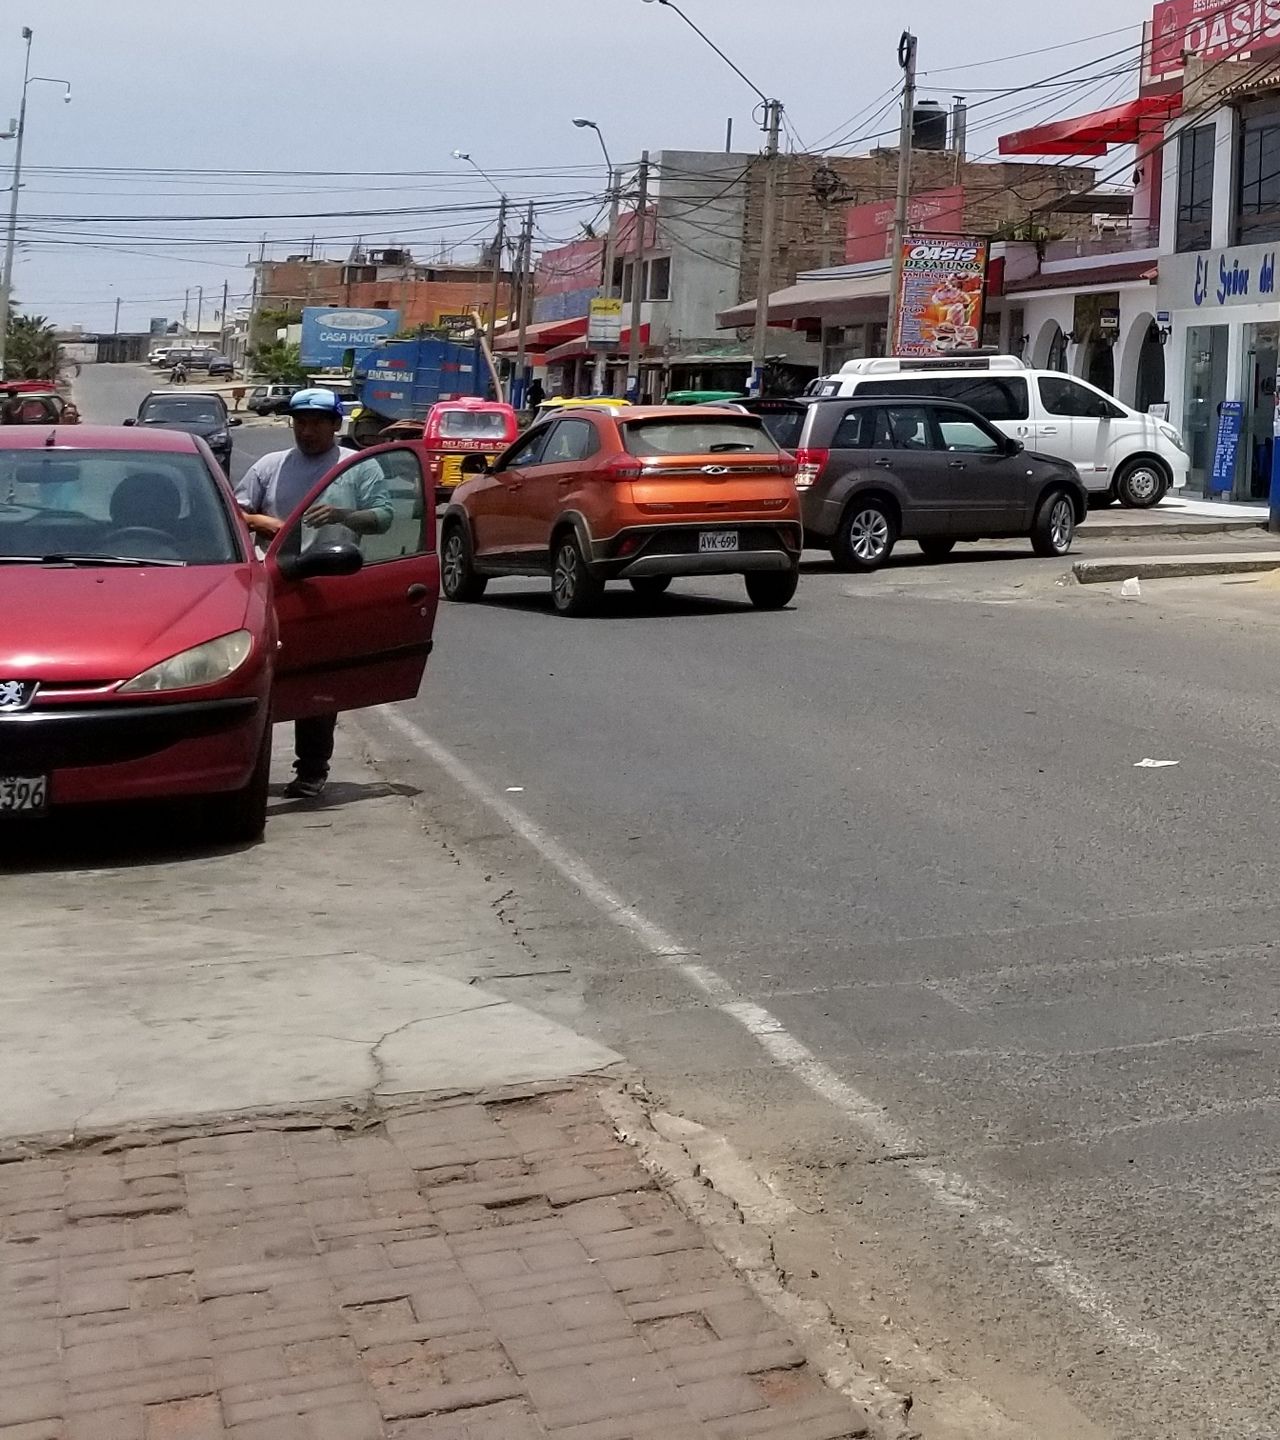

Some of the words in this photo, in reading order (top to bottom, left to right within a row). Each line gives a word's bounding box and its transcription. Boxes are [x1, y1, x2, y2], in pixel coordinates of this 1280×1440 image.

[910, 246, 977, 262] OASIS
[904, 259, 982, 271] DESAYUNOS
[1194, 255, 1209, 306] El
[1217, 254, 1249, 305] Señor
[1259, 252, 1275, 294] del
[319, 332, 347, 342] CASA
